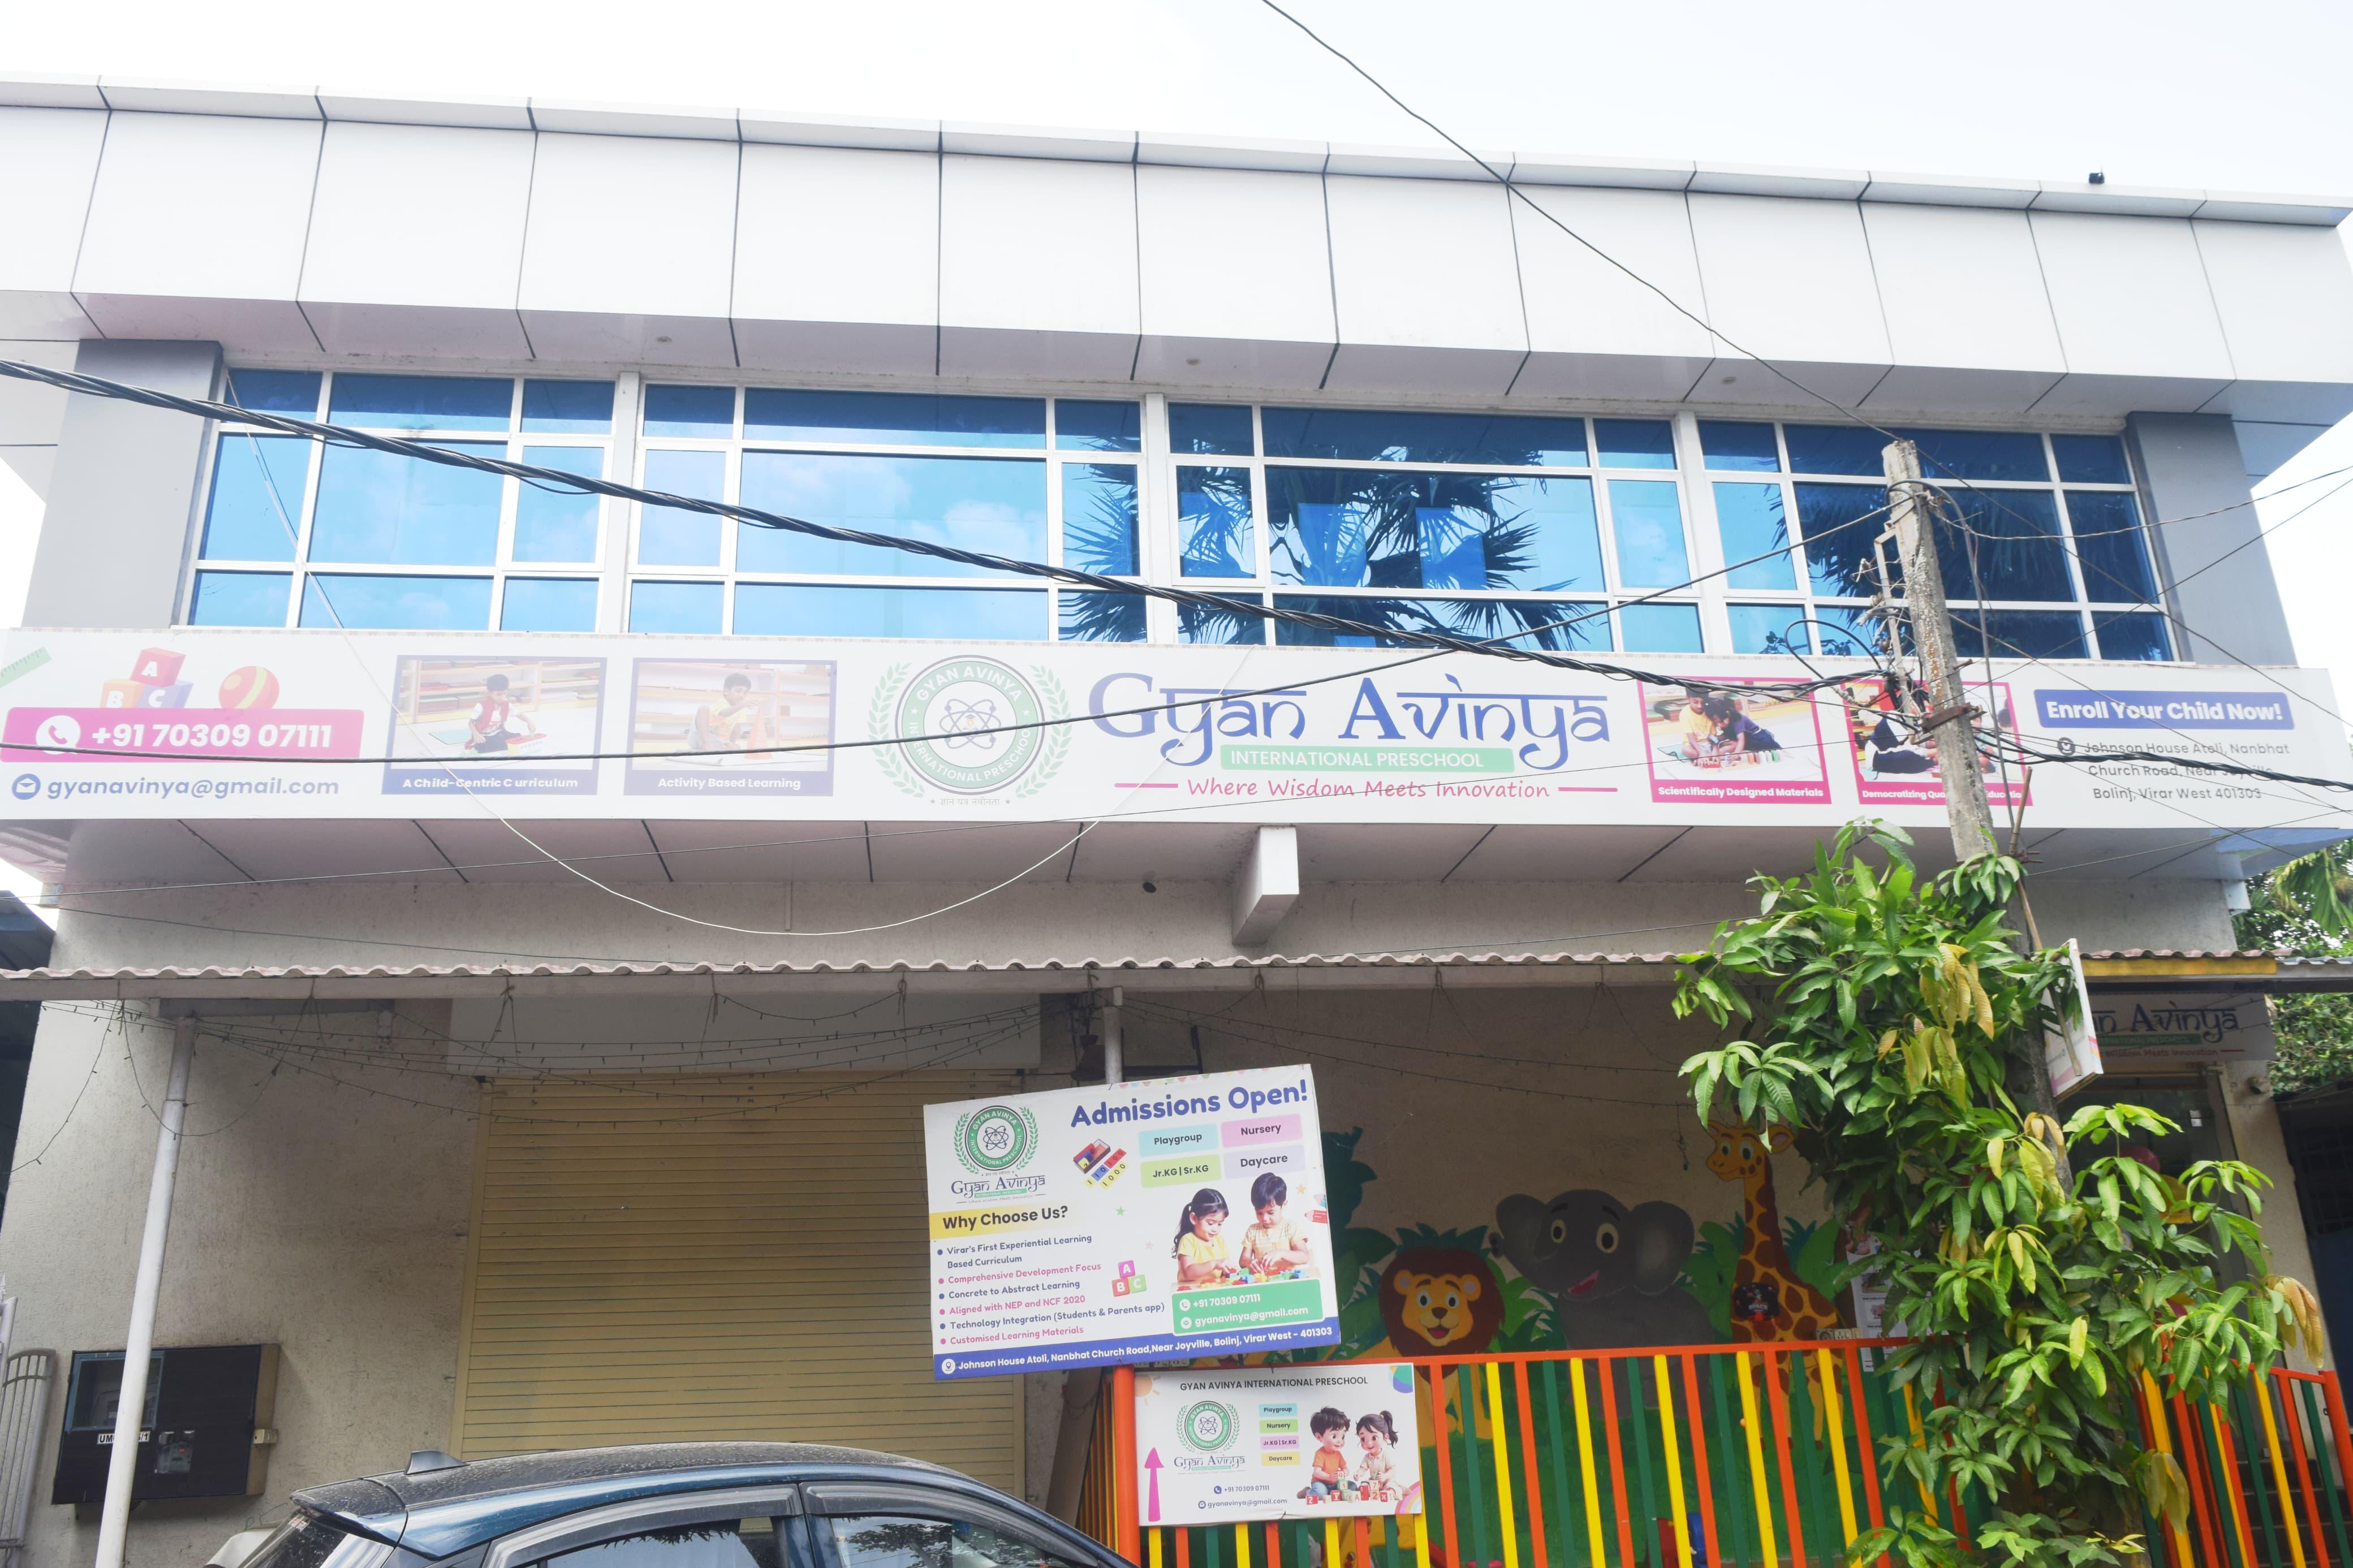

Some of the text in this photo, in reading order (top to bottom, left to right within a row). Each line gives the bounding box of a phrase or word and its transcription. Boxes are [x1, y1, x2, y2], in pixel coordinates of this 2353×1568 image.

[142, 662, 158, 677] A
[917, 666, 1022, 701] GYAN AVINYA
[106, 690, 166, 708] B C
[2046, 701, 2283, 721] Enroll Your Child Now!
[1088, 672, 1610, 770] Gyan Avinya
[92, 724, 332, 748] +91 70309 07111
[984, 729, 1031, 779] PRESCHOO
[2084, 742, 2290, 755] Johnson House Atoli, Nanbhat
[1230, 750, 1484, 768] INTERNATIONAL PRESCHOOL
[2088, 766, 2140, 776] Church
[2145, 766, 2183, 779] Road,
[47, 777, 340, 800] gyanavinya@gmail.com
[403, 779, 412, 788] A
[658, 776, 801, 791] Activity Based Learning
[1187, 778, 1550, 798] Where Wisdom Meets Innovation
[1658, 786, 1824, 798] Scientifically Designed Materials
[1862, 790, 1927, 800] Democratizing
[2093, 788, 2262, 802] Bolinj, Virar West 401303
[2130, 1000, 2239, 1043] Avinya
[1070, 1079, 1308, 1128] Admissions Open!
[973, 1111, 1017, 1130] GYAN AVINYA
[1240, 1123, 1282, 1136] Nursery
[1153, 1133, 1203, 1146] Playgroup
[971, 1135, 1022, 1165] INTERNATIONAL PRESCHOOL
[1240, 1154, 1288, 1168] Daycare
[951, 1174, 1046, 1199] Gyan Avinya
[943, 1205, 1068, 1231] Why Choose Us?
[947, 1234, 1092, 1255] Virar's First Experiential Learning
[947, 1255, 1023, 1269] Based Curriculum
[1123, 1263, 1132, 1273] A
[948, 1262, 1102, 1285] Comprehensive Development Focus
[949, 1280, 1080, 1299] Concrete to Abstract Learning
[1117, 1278, 1142, 1293] B C
[949, 1294, 1086, 1316] Aligned with NEP and NCF 2020
[1193, 1293, 1261, 1307] +91 70309 07111
[950, 1302, 1165, 1331] Technology Integration (Students & Parents app)
[1195, 1307, 1309, 1328] gyanavinya@gmail.com
[950, 1325, 1084, 1345] Customised Learning Materials
[958, 1359, 996, 1370] Johnson
[998, 1357, 1025, 1366] House
[1027, 1353, 1050, 1365] Atoli,
[1051, 1350, 1091, 1362] Nanbhat
[1092, 1347, 1125, 1359] Church
[1175, 1338, 1213, 1351] Joyville,
[1214, 1337, 1243, 1347] Bolinj,
[1243, 1334, 1267, 1344] Virar
[1268, 1331, 1292, 1341] West
[1300, 1327, 1332, 1338] 401303
[1180, 1376, 1368, 1391] GYAN AVINYA INTERNATIONAL PRESCHOOL
[1190, 1405, 1223, 1419] GYAN AVINYA
[1264, 1406, 1292, 1414] Playgroup
[1266, 1422, 1291, 1430] Nursery
[1174, 1454, 1245, 1471] Gyan Avinya
[1208, 1498, 1288, 1508] gyanavinya@gmail.com
